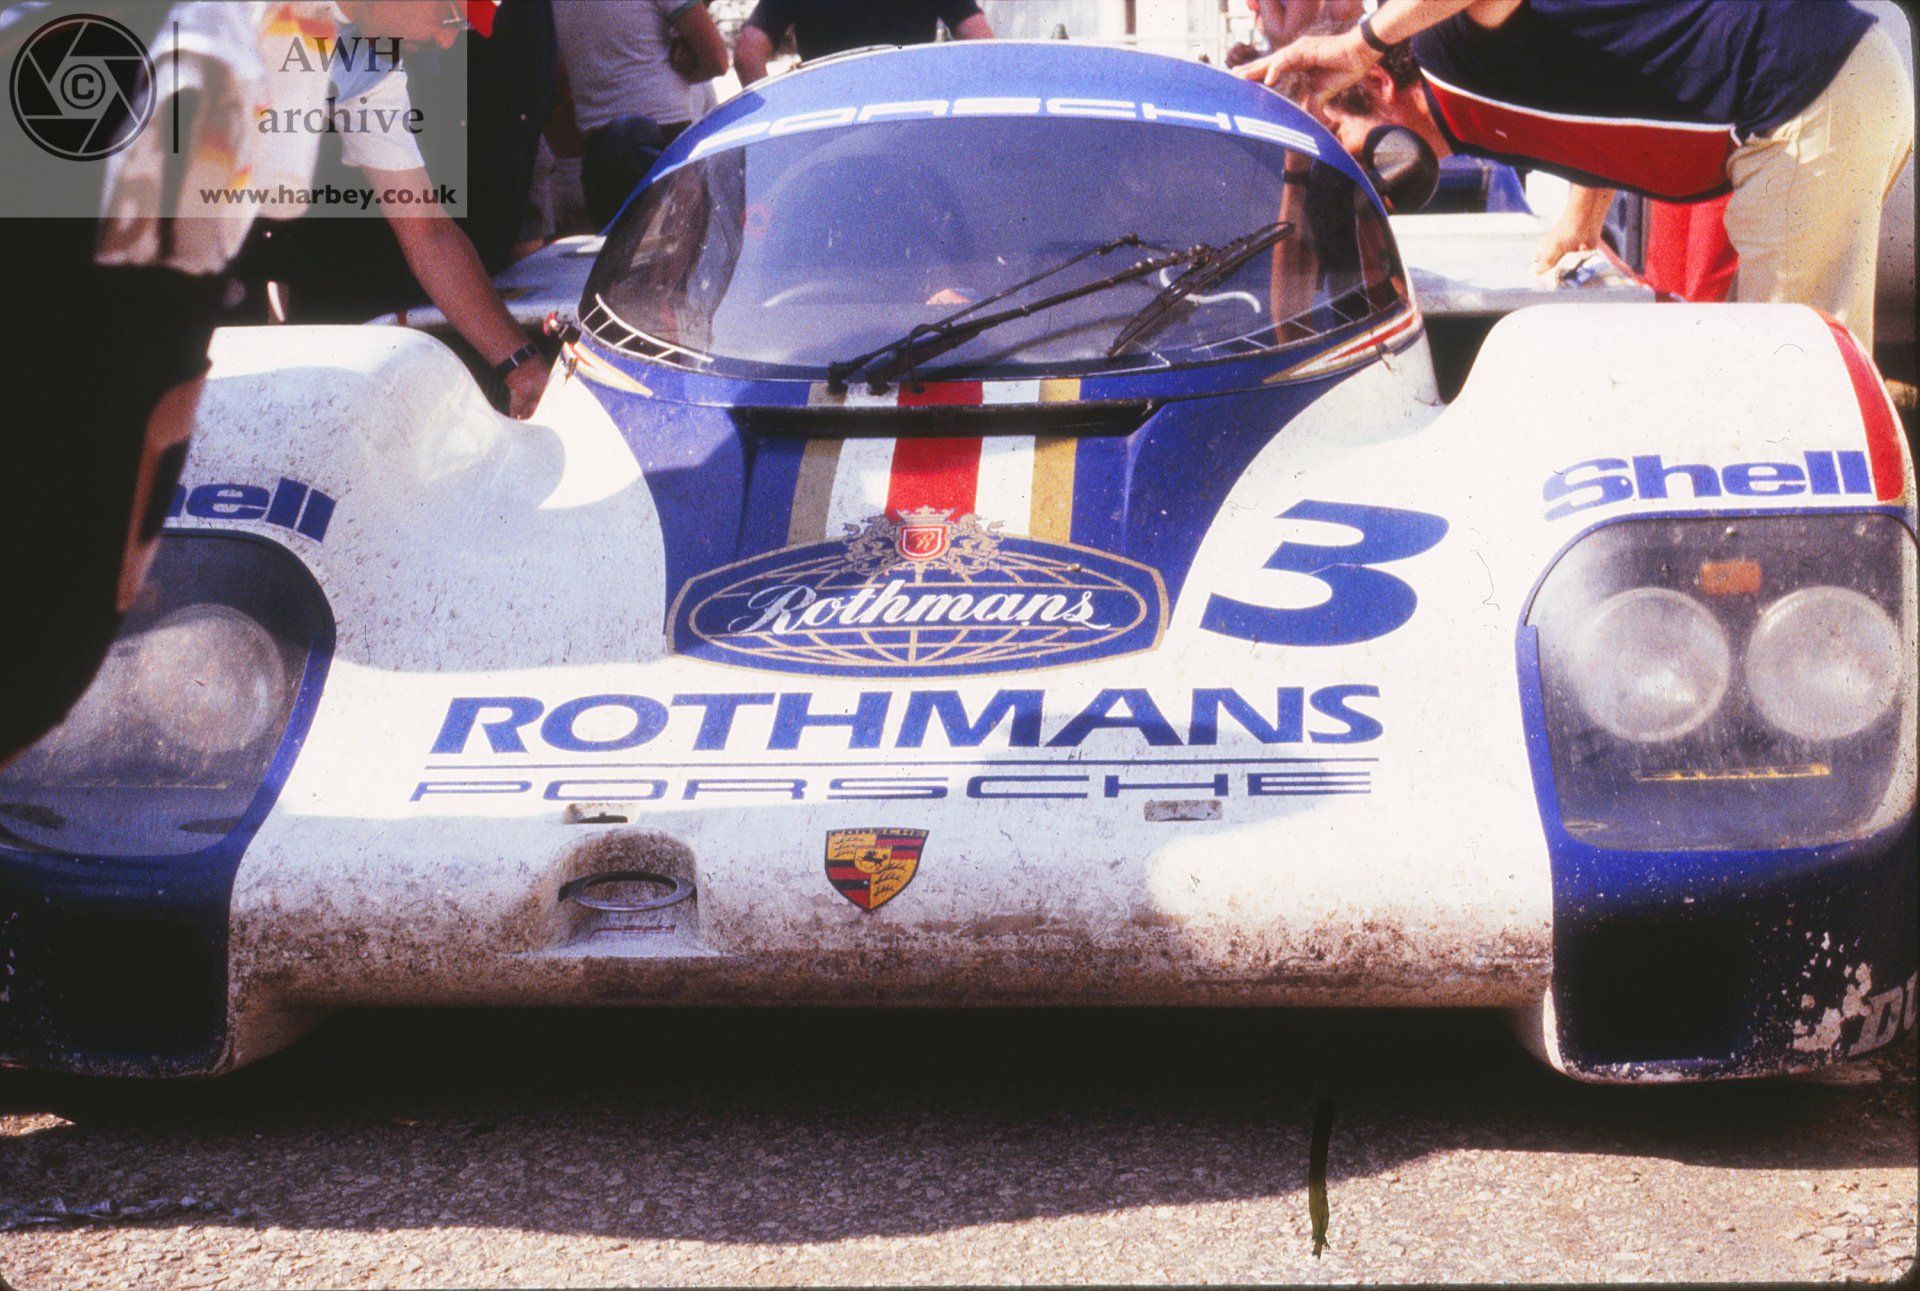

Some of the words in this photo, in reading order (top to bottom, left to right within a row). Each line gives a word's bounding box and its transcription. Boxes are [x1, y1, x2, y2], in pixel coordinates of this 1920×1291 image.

[687, 97, 1321, 158] PORSCHE
[1543, 450, 1873, 522] Shell
[1199, 499, 1449, 647] 3
[728, 579, 1111, 635] Rothmans
[429, 684, 1383, 754] ROTHMANS
[409, 771, 1371, 801] PORSCHE
